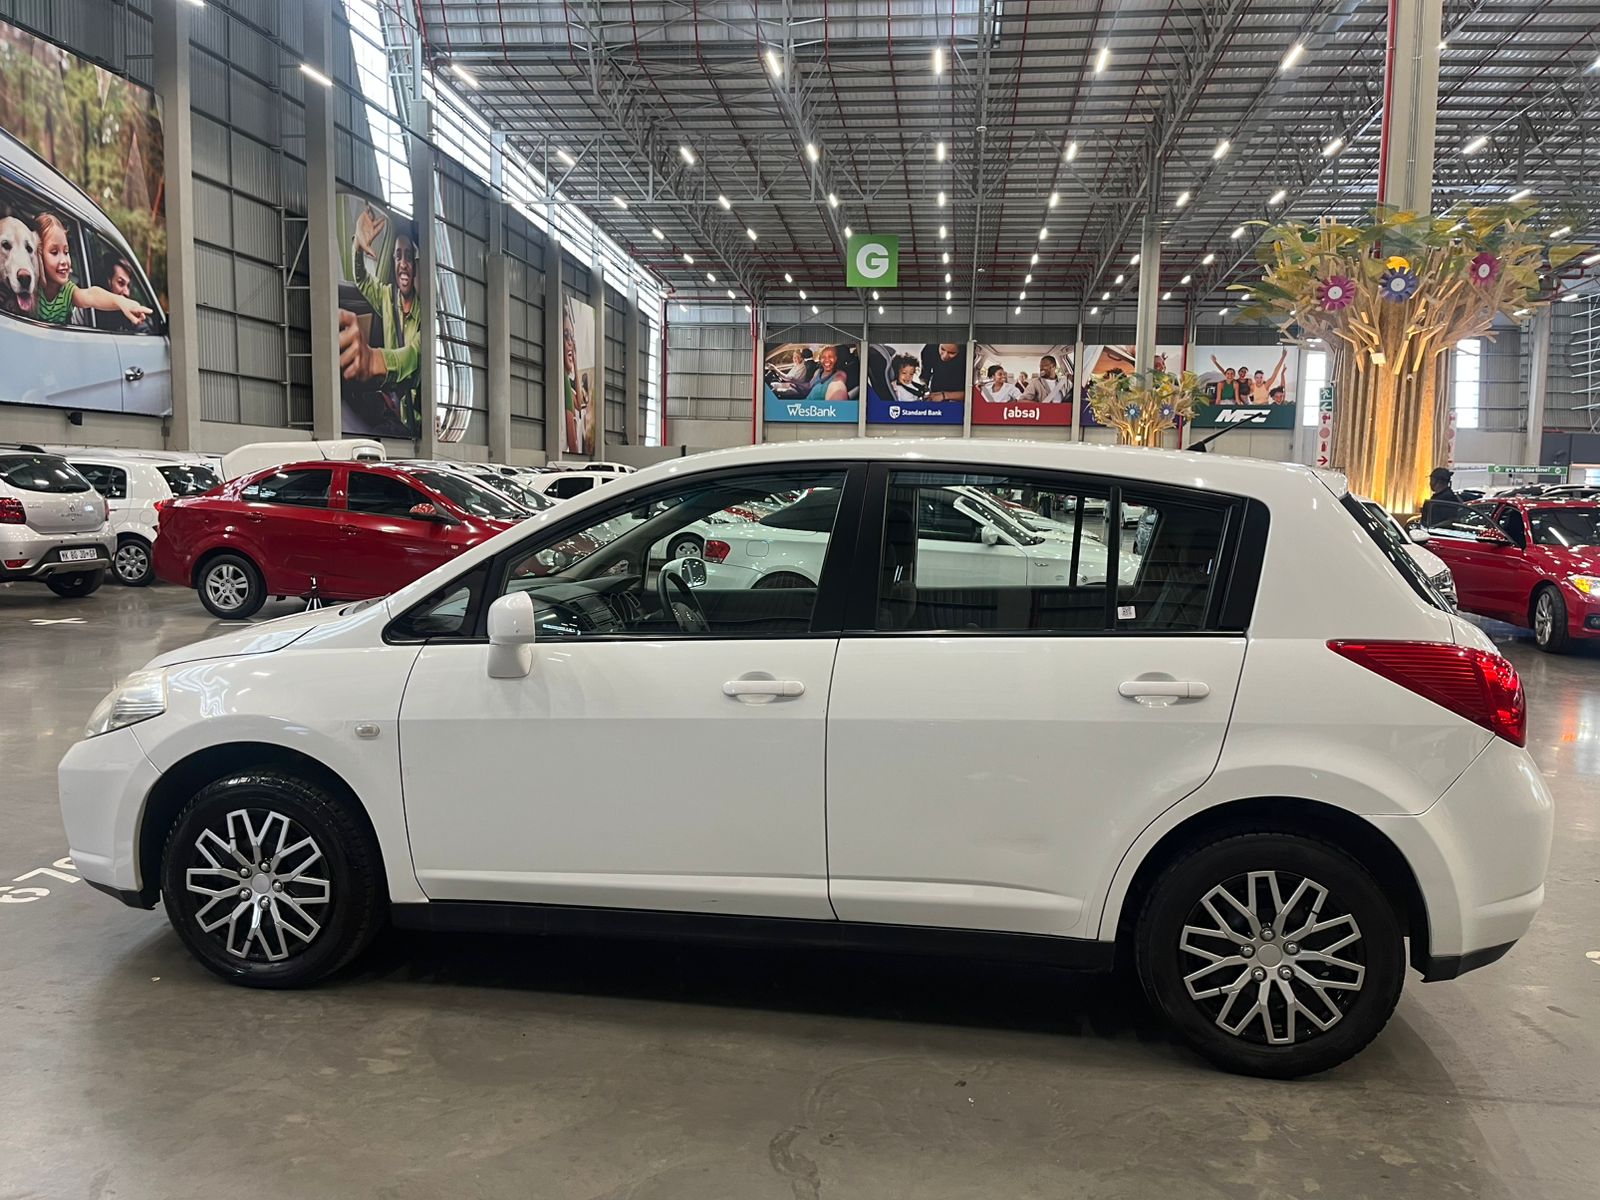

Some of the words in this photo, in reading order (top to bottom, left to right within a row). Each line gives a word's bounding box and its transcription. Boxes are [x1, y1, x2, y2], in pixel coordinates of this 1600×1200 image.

[856, 243, 889, 279] G
[786, 403, 837, 417] WesBank
[1003, 406, 1040, 421] (absa)
[1214, 409, 1271, 423] MFC
